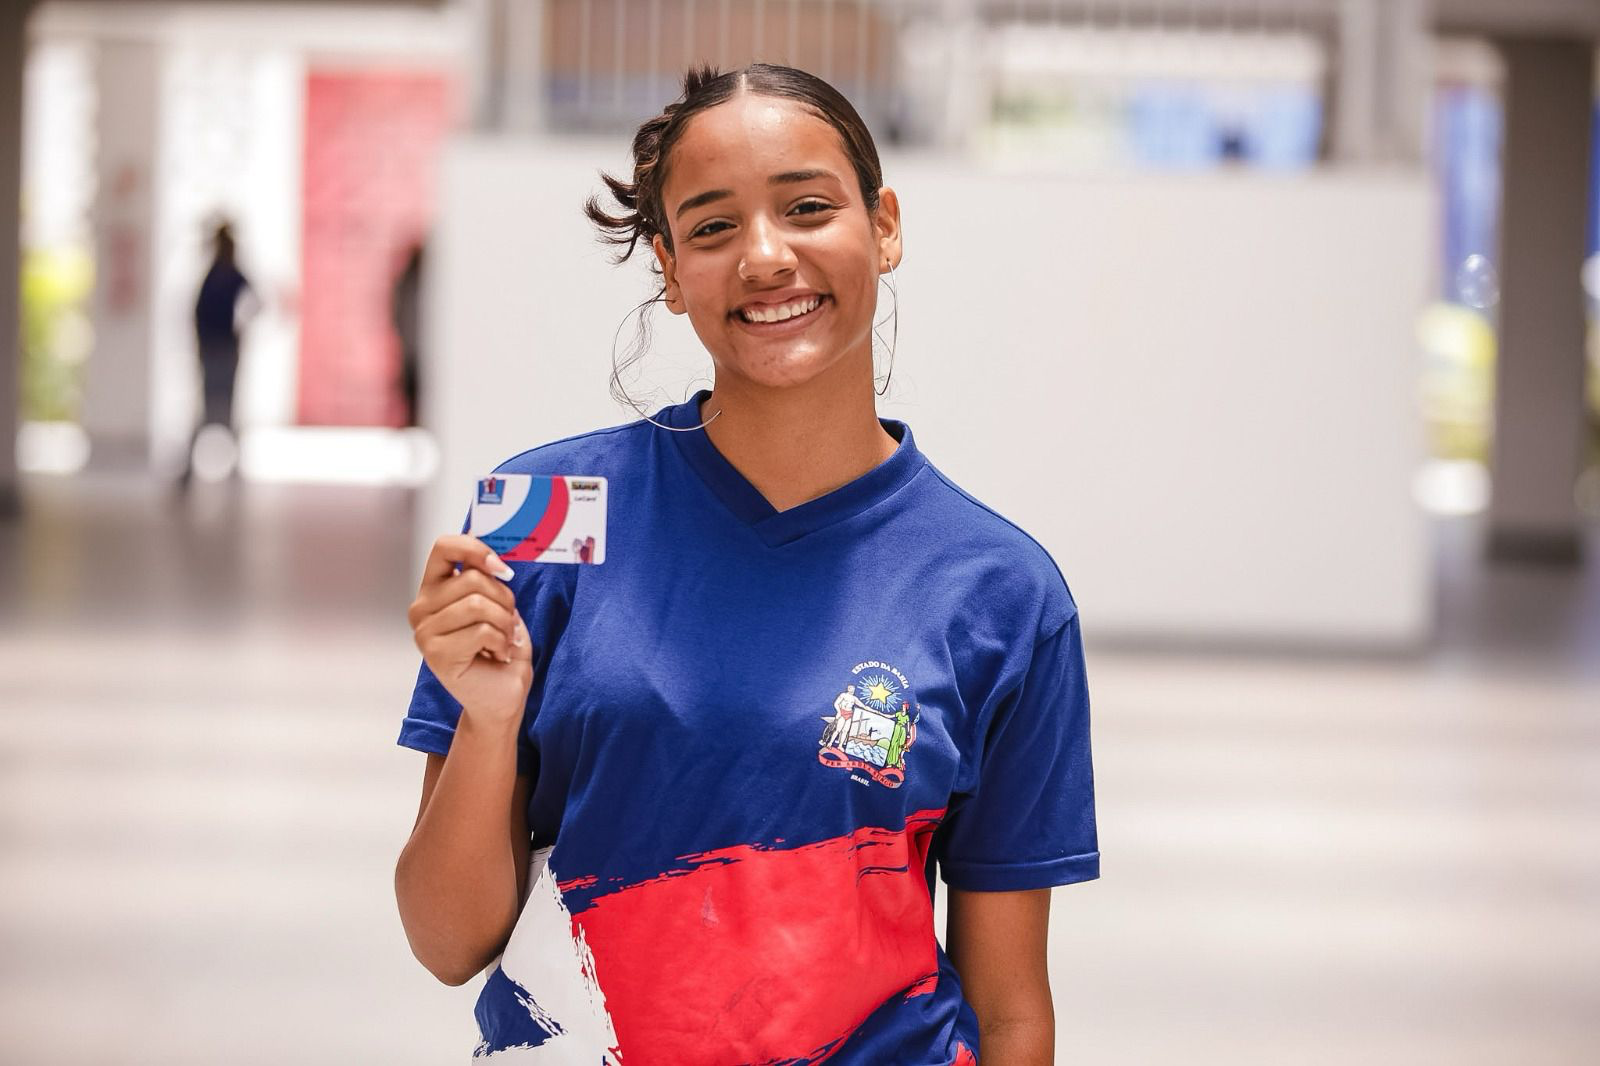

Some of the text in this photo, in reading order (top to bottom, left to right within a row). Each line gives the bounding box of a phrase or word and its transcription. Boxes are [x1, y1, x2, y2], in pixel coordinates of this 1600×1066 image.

[852, 661, 910, 689] ESTADO DA BAHIA
[851, 775, 870, 787] BRASIL
